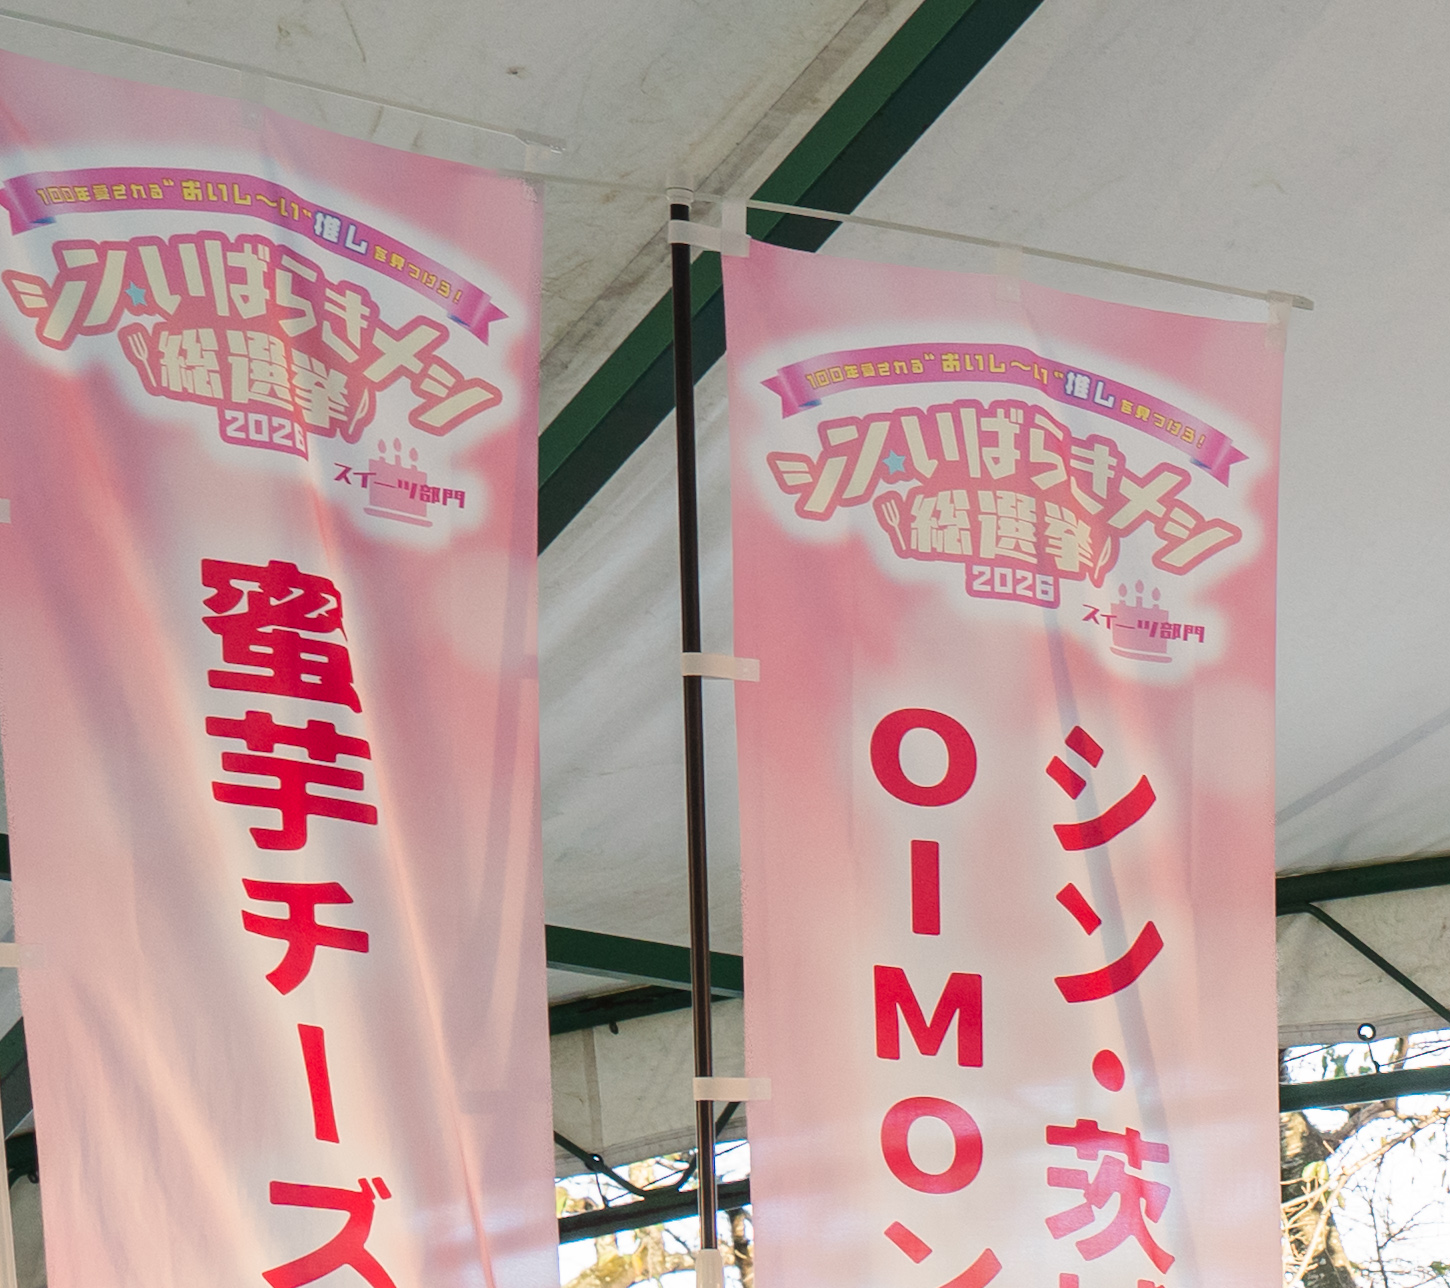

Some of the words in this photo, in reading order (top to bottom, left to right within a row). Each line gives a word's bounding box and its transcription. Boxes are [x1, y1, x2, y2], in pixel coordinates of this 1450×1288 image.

[160, 329, 350, 431] 総選挙
[225, 411, 308, 452] 2026
[910, 490, 1093, 573] 総選挙
[971, 566, 1054, 601] 2026
